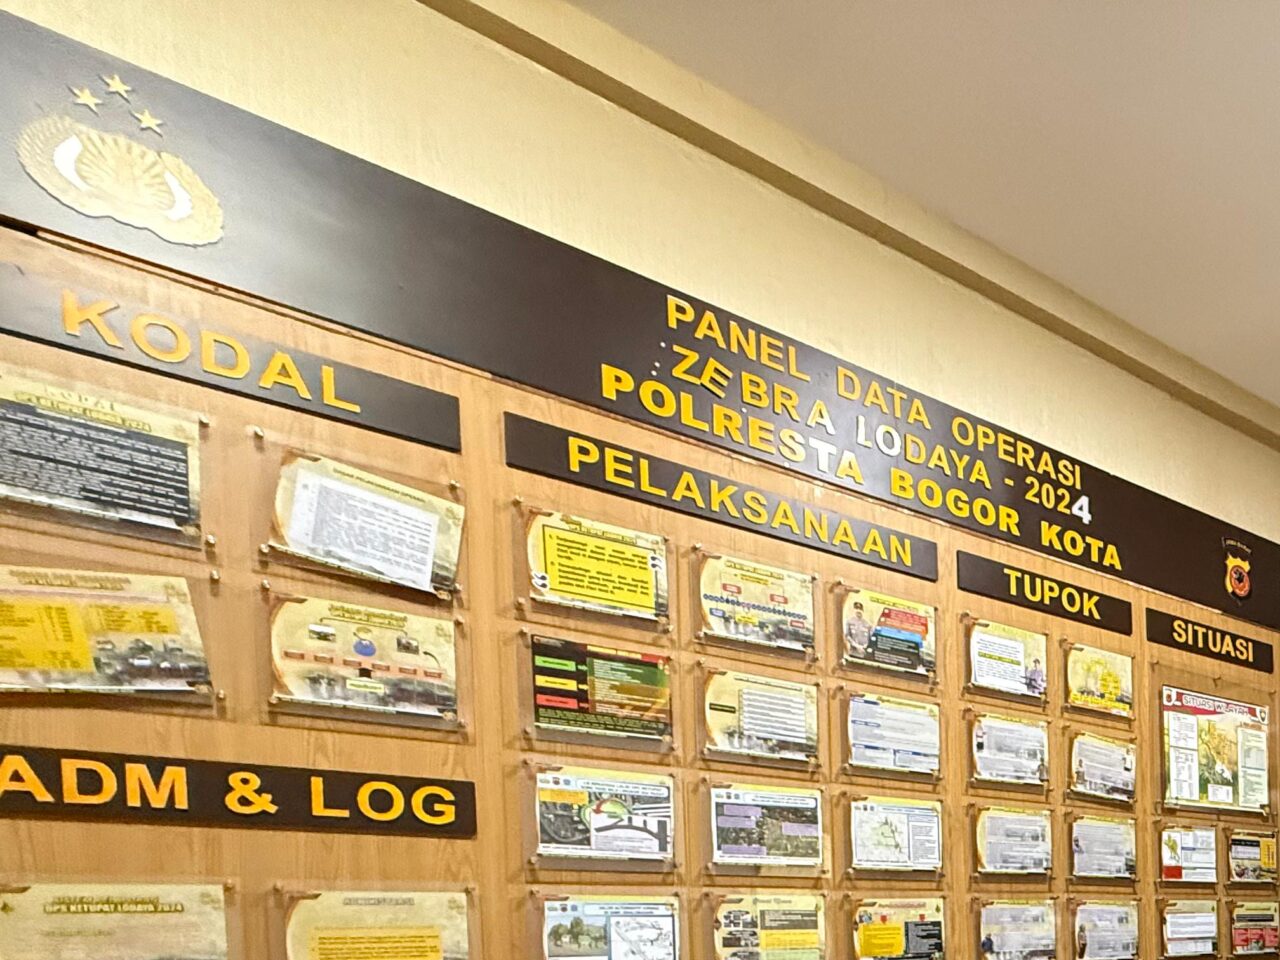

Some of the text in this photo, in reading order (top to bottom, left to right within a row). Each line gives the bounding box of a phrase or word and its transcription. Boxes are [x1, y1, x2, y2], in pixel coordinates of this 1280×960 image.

[60, 290, 361, 413] KODAL
[666, 294, 1082, 491] PANEL DATA OPERASI
[601, 364, 1123, 570] POLRESTA BOGOR KOTA
[670, 345, 836, 434] ZEBRA
[856, 414, 989, 491] LODAYA
[1023, 475, 1092, 525] 2024
[567, 436, 913, 568] PELAKSANAAN
[1004, 567, 1101, 621] TUPOK
[1172, 619, 1254, 662] SITUASI
[0, 755, 456, 825] ADM & LOG
